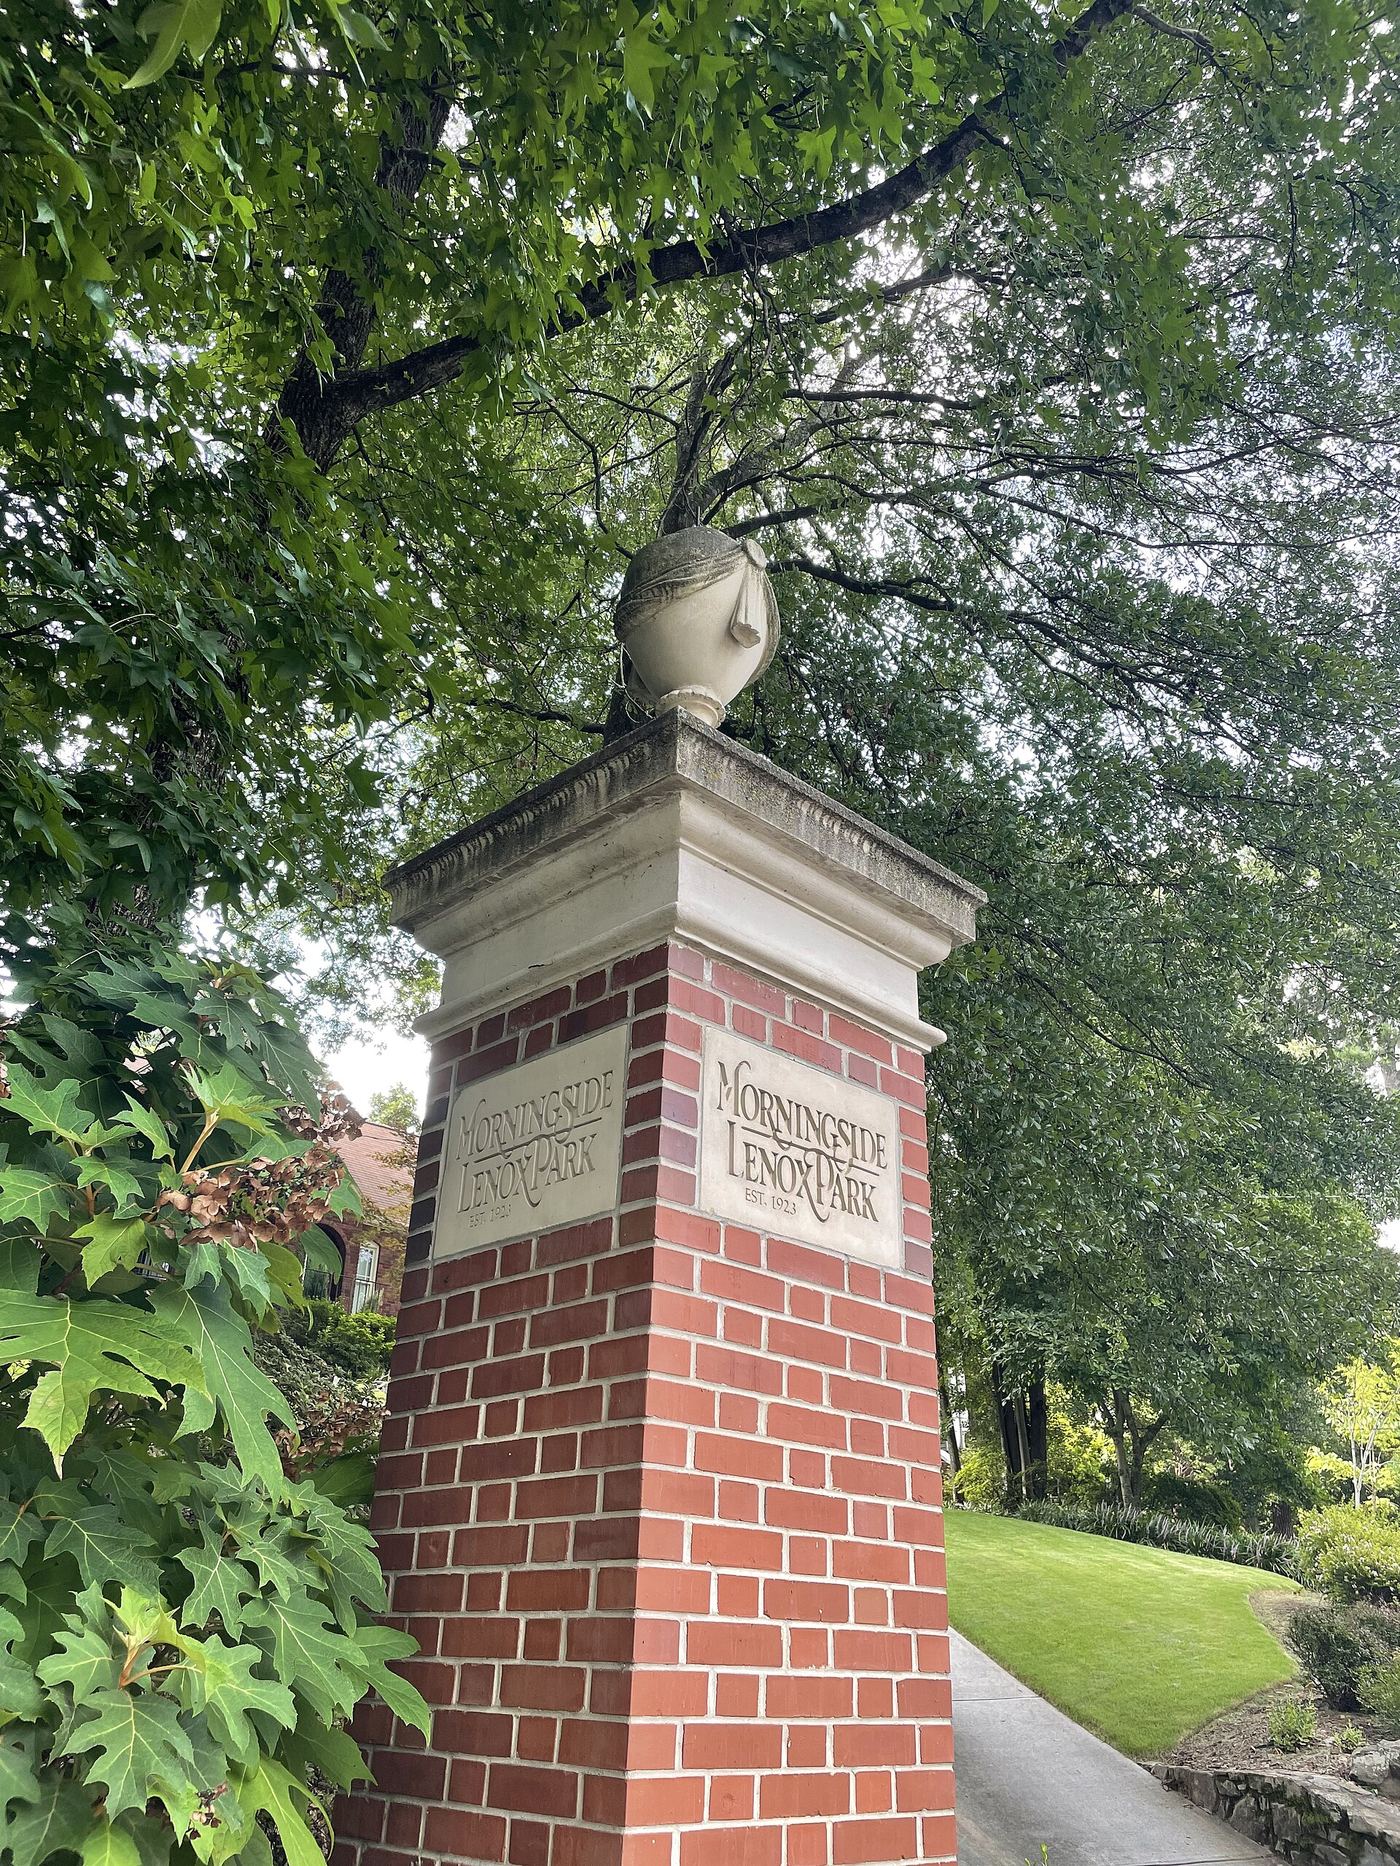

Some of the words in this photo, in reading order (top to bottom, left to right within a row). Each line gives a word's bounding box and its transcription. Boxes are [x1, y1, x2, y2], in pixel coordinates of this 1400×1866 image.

[456, 1070, 614, 1160] MORNINGSIDE
[716, 1060, 888, 1171] MORNINGSIDE
[457, 1152, 541, 1213] LENOX
[524, 1133, 597, 1191] PARK
[727, 1120, 830, 1223] LENOX
[803, 1148, 879, 1222] PARK
[745, 1188, 767, 1206] EST.
[771, 1196, 796, 1215] 1923
